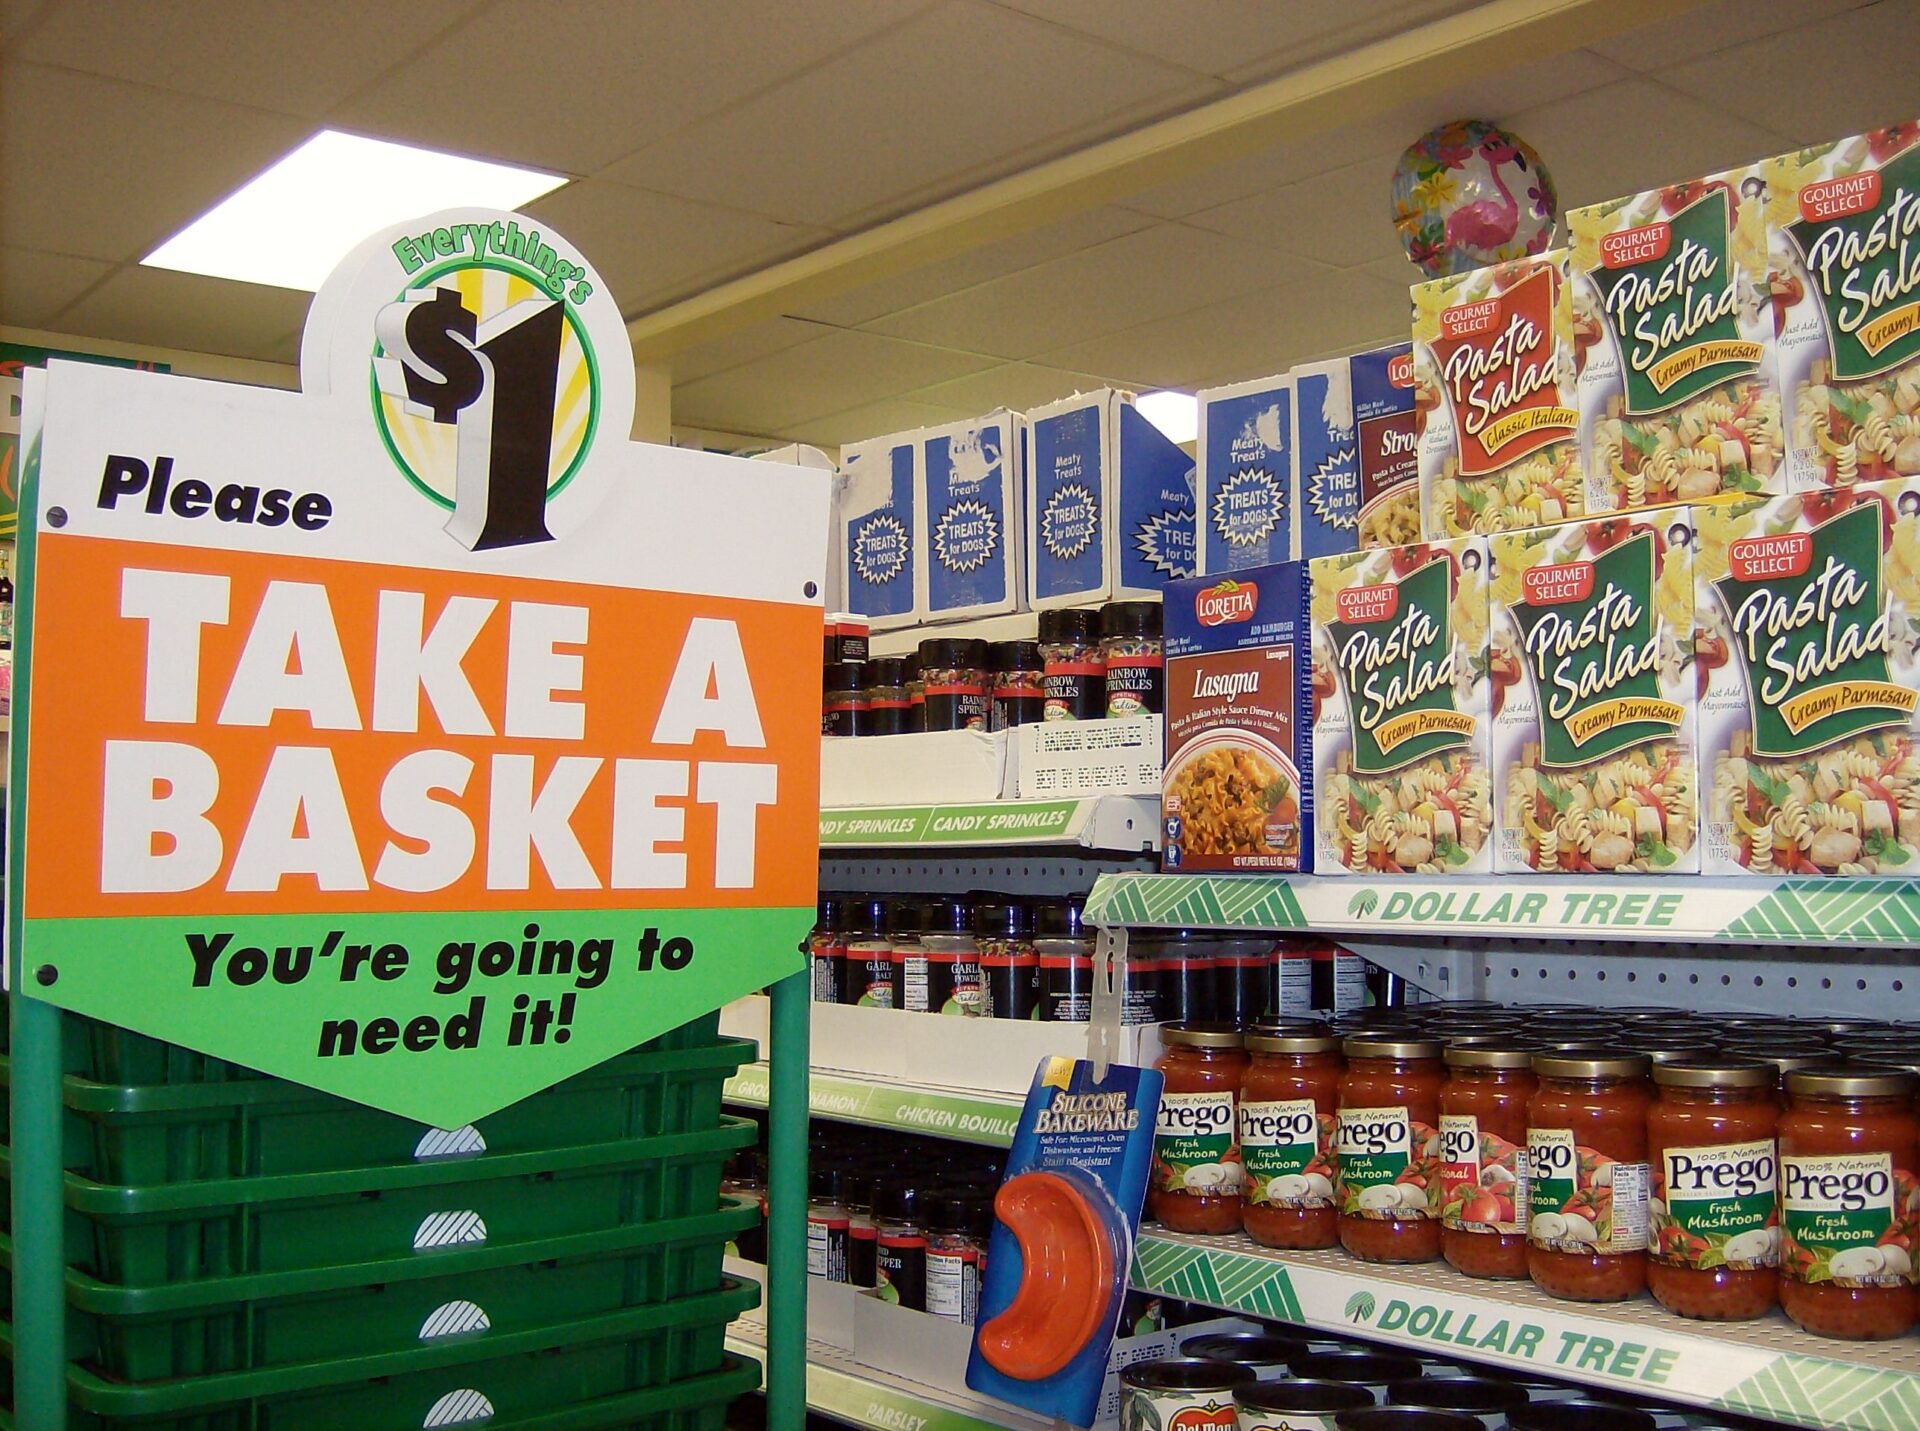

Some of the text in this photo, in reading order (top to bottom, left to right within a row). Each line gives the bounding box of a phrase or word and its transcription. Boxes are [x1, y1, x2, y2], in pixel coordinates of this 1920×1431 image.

[1803, 175, 1875, 205] GOURMET
[1815, 193, 1865, 217] SELECT
[1603, 226, 1664, 252] GOURMET
[391, 221, 593, 305] Everything's
[1613, 243, 1656, 264] SELECT
[1606, 238, 1718, 337] Pasta
[1443, 302, 1497, 325] GOURMET
[1632, 261, 1740, 371] Salad
[1451, 316, 1489, 336] SELECT
[1866, 313, 1913, 349] Creamy
[1444, 313, 1543, 402] Pasta
[1655, 345, 1759, 386] Creamy Parmesan
[1465, 335, 1561, 434] Salad
[371, 285, 565, 551] $1
[1486, 406, 1573, 449] Classic Italian
[1231, 438, 1264, 451] Meaty
[1055, 453, 1081, 468] Meaty
[1230, 449, 1266, 464] Treats
[1054, 465, 1082, 480] Treats
[97, 454, 333, 531] Please
[948, 484, 980, 497] Treats
[1161, 489, 1189, 507] Meaty
[1229, 489, 1268, 510] TREATS
[1328, 494, 1343, 508] for
[1054, 504, 1086, 525] TREATS
[1230, 509, 1268, 527] for DOGS
[949, 521, 984, 540] TREATS
[1054, 523, 1085, 541] for DOGS
[866, 535, 897, 553] TREATS
[949, 538, 984, 555] for DOGS
[1165, 548, 1180, 560] for
[1733, 538, 1806, 560] GOURMET
[876, 552, 897, 565] DOGS
[1744, 556, 1795, 576] SELECT
[1526, 566, 1589, 586] GOURMET
[1340, 588, 1394, 606] GOURMET
[1536, 583, 1580, 600] SELECT
[1199, 592, 1254, 624] LORETTA
[1348, 603, 1386, 619] SELECT
[1733, 555, 1869, 662] Pasta
[1525, 583, 1643, 680] Pasta
[1339, 603, 1440, 693] Pasta
[1761, 589, 1894, 705] Salad
[121, 567, 768, 749] TAKE A
[1549, 613, 1664, 720] Salad
[1192, 669, 1260, 703] Lasagna
[1360, 631, 1458, 730] Salad
[1229, 705, 1248, 714] Sauce
[1249, 706, 1273, 718] Dinner
[1275, 711, 1288, 724] Mix
[1790, 686, 1913, 727] Creamy Parmesan
[1380, 714, 1472, 748] Creamy Parmesan
[1573, 702, 1680, 739] Creamy Parmesan
[101, 740, 779, 894] BASKET
[846, 818, 916, 835] SPRINKLES
[932, 809, 1067, 832] CANDY SPRINKLES
[1380, 890, 1685, 926] DOLLAR TREE
[185, 923, 696, 995] You're going to
[317, 994, 577, 1060] need it!
[1051, 1091, 1127, 1114] SILICONE
[1192, 1095, 1229, 1105] Natural
[1272, 1103, 1311, 1113] Natural
[896, 1104, 956, 1127] CHICKEN
[1033, 1109, 1140, 1134] BAKEWARE
[1364, 1111, 1403, 1121] Natural
[1107, 1133, 1126, 1142] Oven
[1175, 1138, 1199, 1148] Fresh
[1534, 1133, 1568, 1142] Natural
[1161, 1149, 1218, 1159] Mushroom
[1257, 1149, 1280, 1158] Fresh
[1349, 1157, 1373, 1167] Fresh
[1696, 1146, 1771, 1162] 100% Natural
[1246, 1160, 1301, 1170] Mushroom
[1340, 1167, 1393, 1179] Mushroom
[1804, 1158, 1886, 1171] 100% Natural
[1668, 1155, 1774, 1197] Prego
[1784, 1163, 1889, 1212] Prego
[1709, 1200, 1742, 1214] Fresh
[1688, 1213, 1763, 1229] Mushroom
[1815, 1214, 1849, 1227] Fresh
[1797, 1227, 1875, 1241] Mushroom
[1376, 1299, 1680, 1384] DOLLAR TREE
[866, 1402, 928, 1431] PARSLEY
